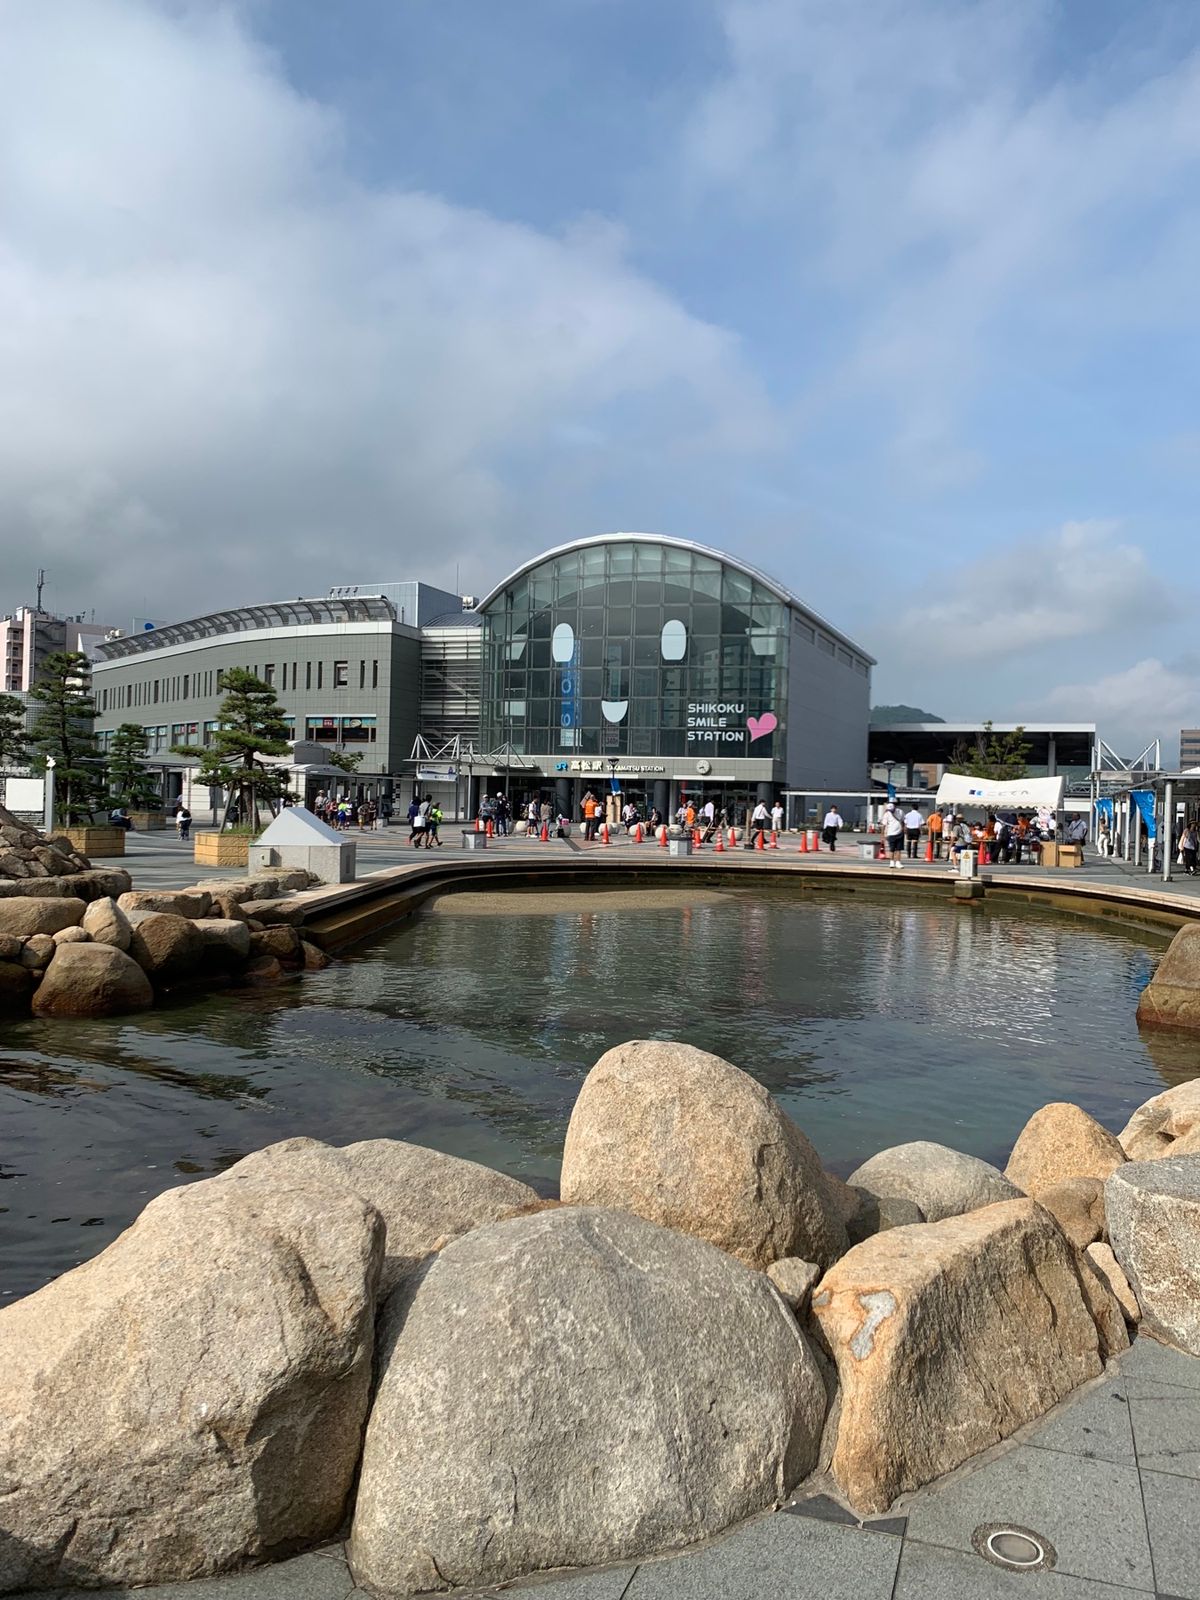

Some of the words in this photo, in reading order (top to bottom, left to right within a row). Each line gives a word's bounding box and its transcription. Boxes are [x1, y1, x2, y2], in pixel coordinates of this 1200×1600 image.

[687, 703, 745, 713] SHIKOKU
[687, 717, 727, 727] SMILE
[687, 731, 744, 741] STATION
[571, 760, 602, 770] 高松駅
